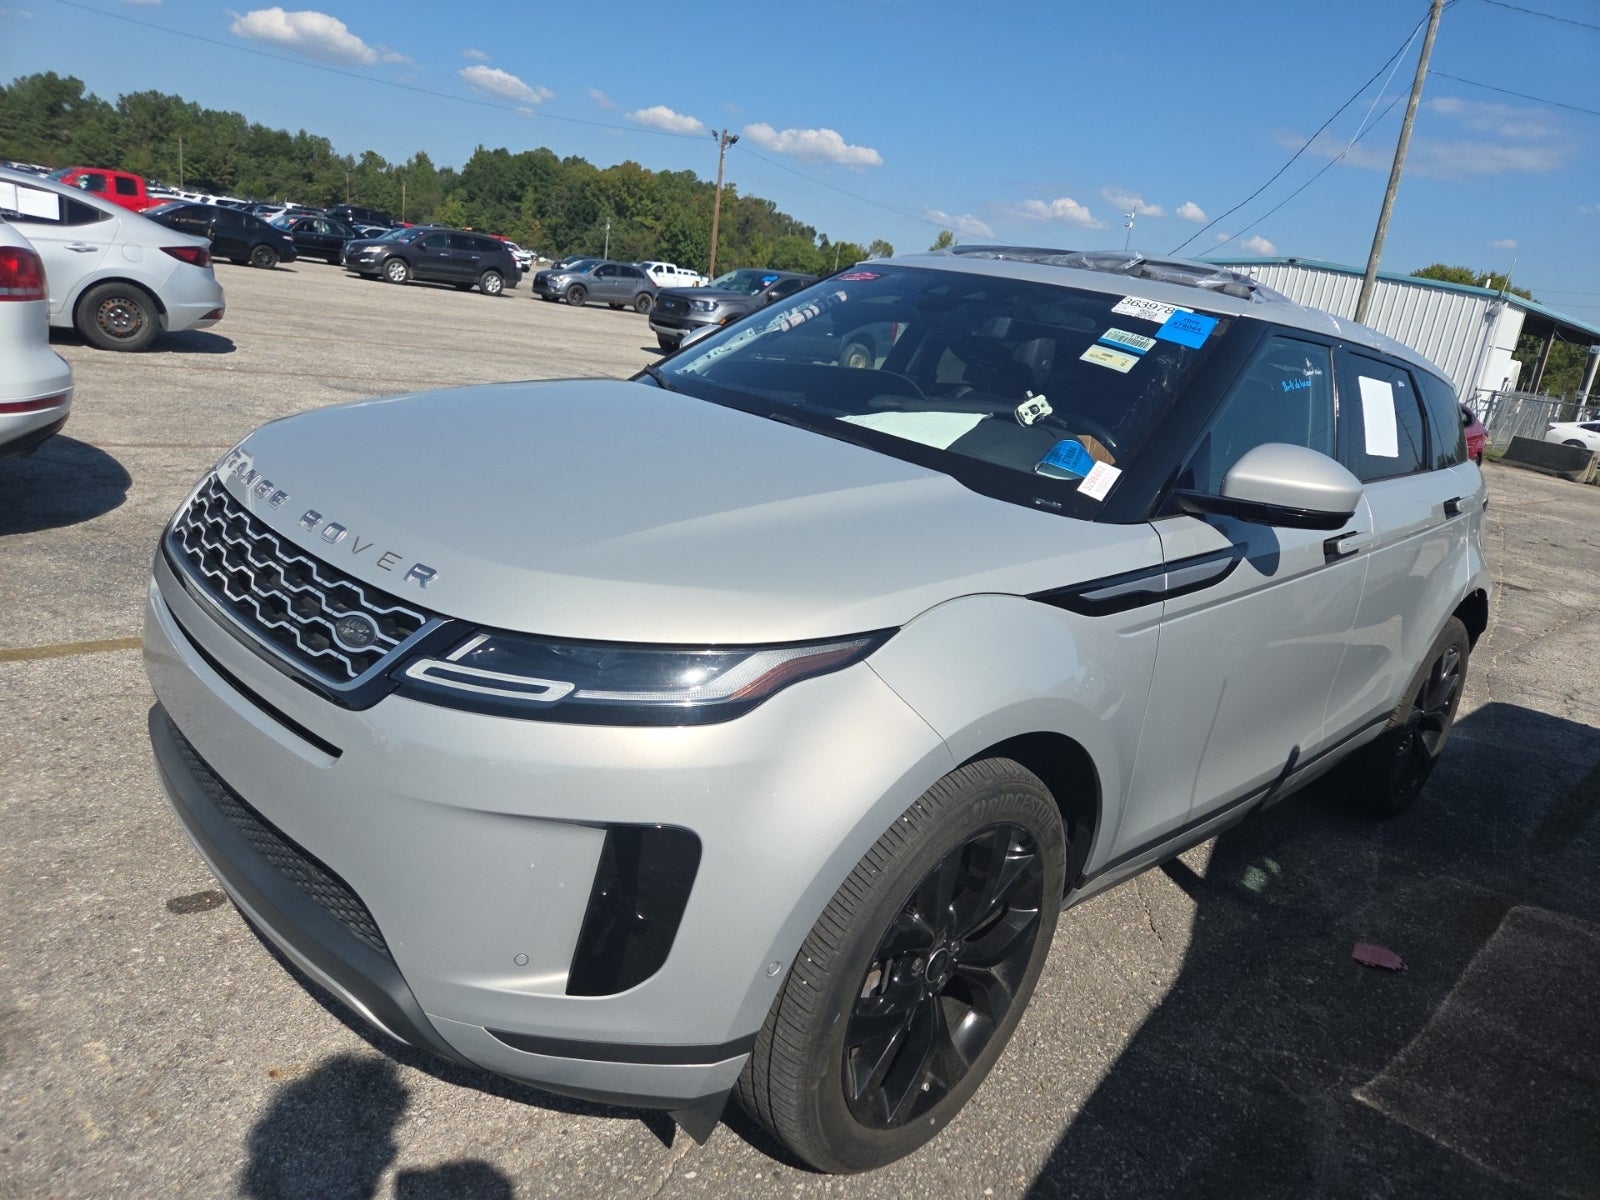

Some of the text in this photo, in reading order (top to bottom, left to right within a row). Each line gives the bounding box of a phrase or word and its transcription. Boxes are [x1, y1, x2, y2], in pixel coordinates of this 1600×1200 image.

[1121, 296, 1175, 315] 363978
[226, 450, 439, 589] RANGE ROVER
[342, 627, 368, 643] ROVER
